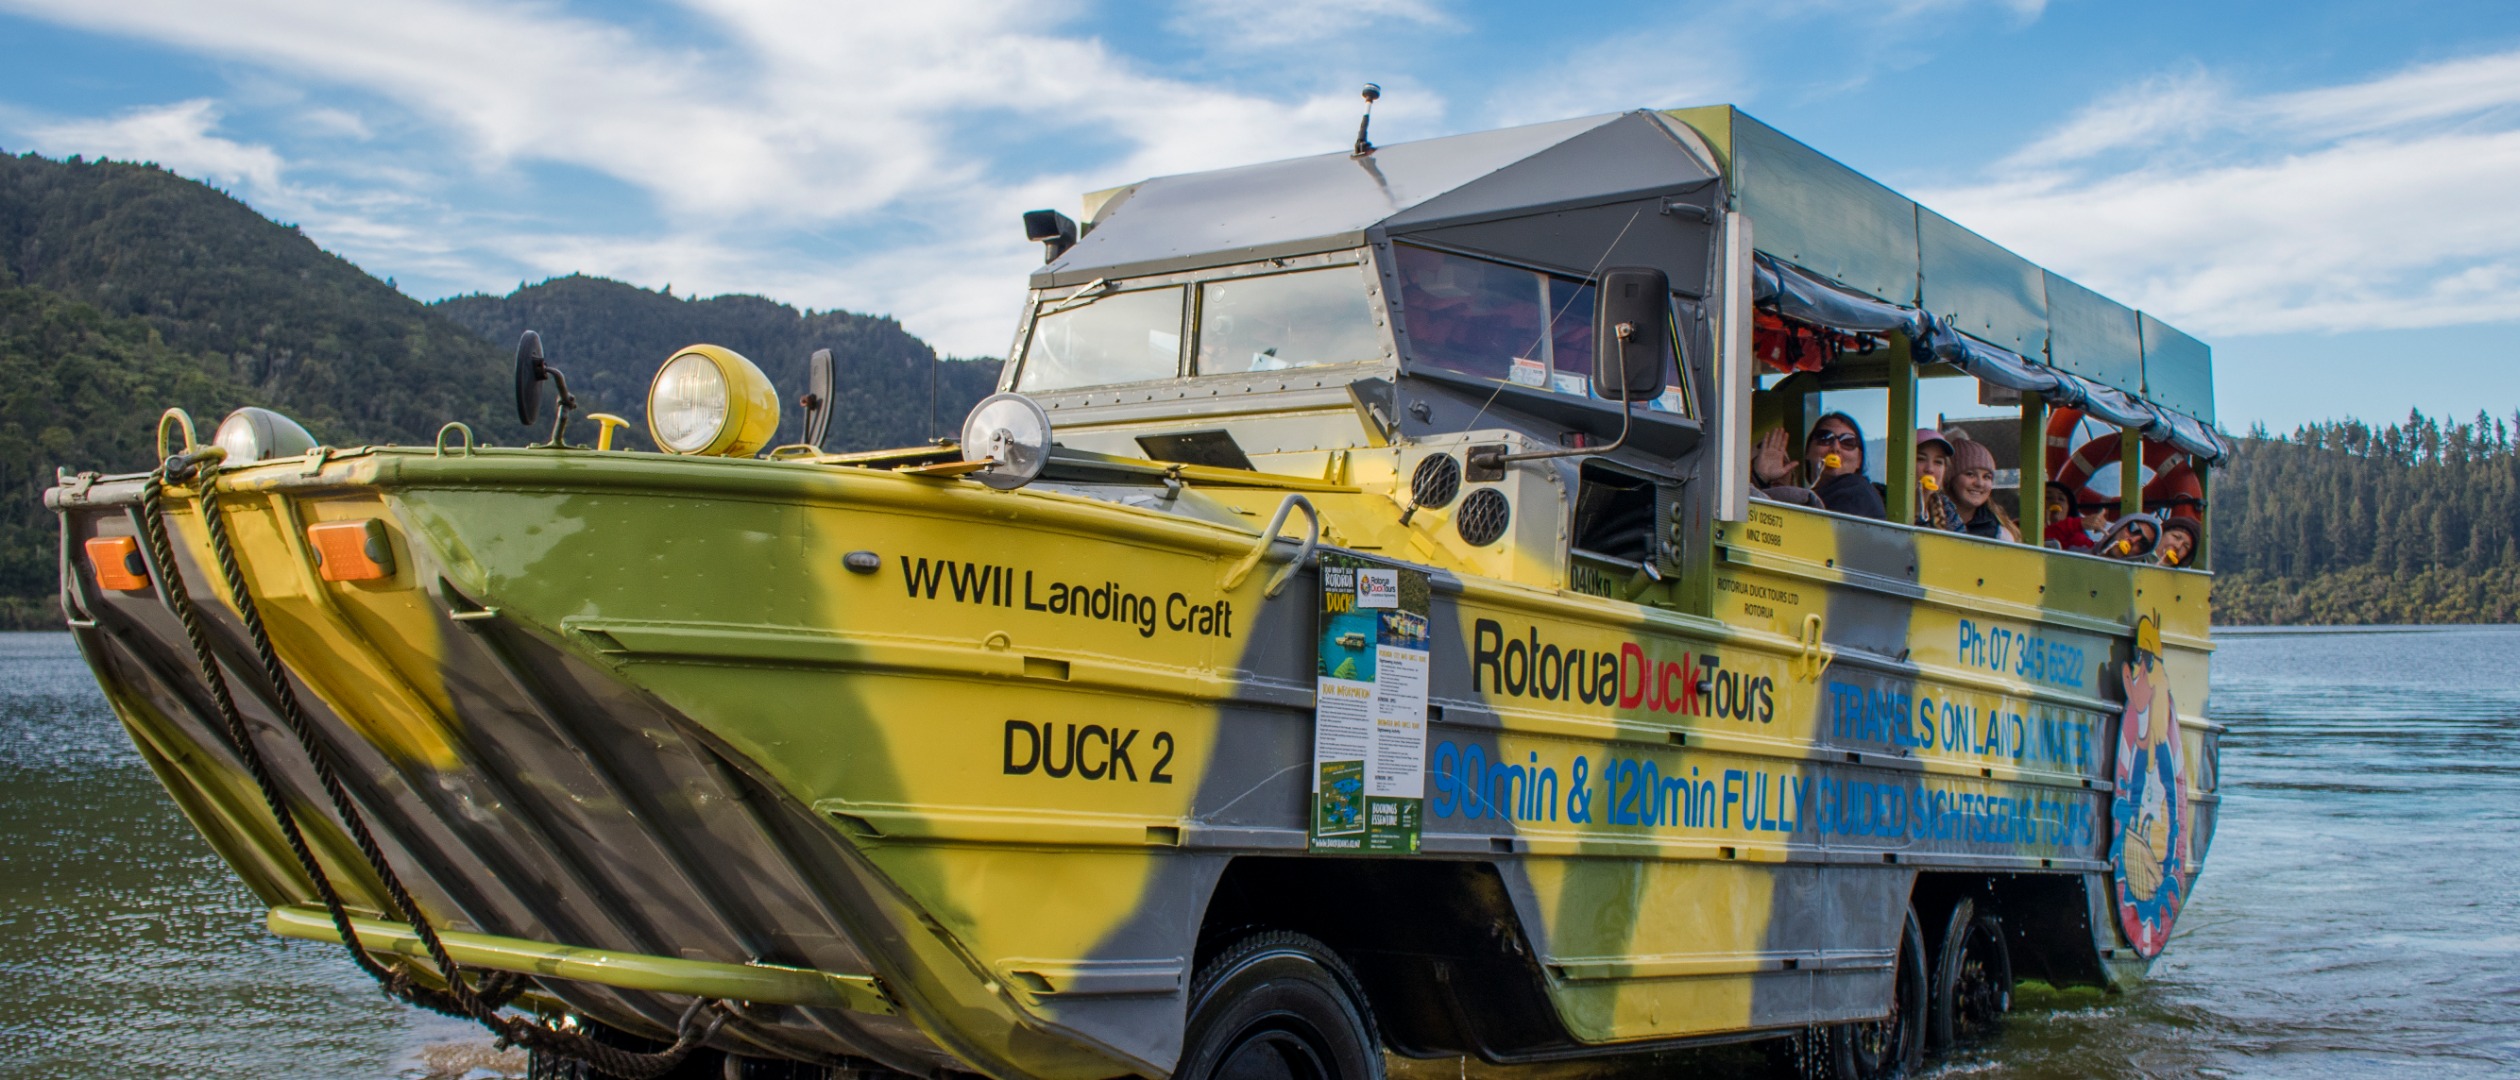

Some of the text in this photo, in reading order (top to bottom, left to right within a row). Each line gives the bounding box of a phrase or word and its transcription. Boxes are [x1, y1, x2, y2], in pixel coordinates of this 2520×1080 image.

[1746, 528, 1760, 542] MNZ
[900, 555, 1232, 638] WWII Landing Craft
[1717, 577, 1799, 605] ROTORUA DUCK TOURS LTD
[1744, 602, 1774, 619] ROTORUA
[1959, 618, 2084, 688] Ph: 07 345 6522
[1003, 719, 1175, 784] DUCK 2
[1828, 681, 1936, 749] TRAVELS
[1941, 701, 1968, 753] ON
[1973, 707, 2025, 759] LAND
[2038, 718, 2093, 767] WATER
[1432, 740, 1557, 823] 90min
[1566, 755, 1592, 824] &
[1604, 757, 1715, 828] 120min
[1722, 769, 1812, 833] FULLY
[1816, 775, 1908, 837] GUIDED
[1912, 785, 2037, 845] SIGHTSEEING
[2040, 800, 2092, 847] TOURS
